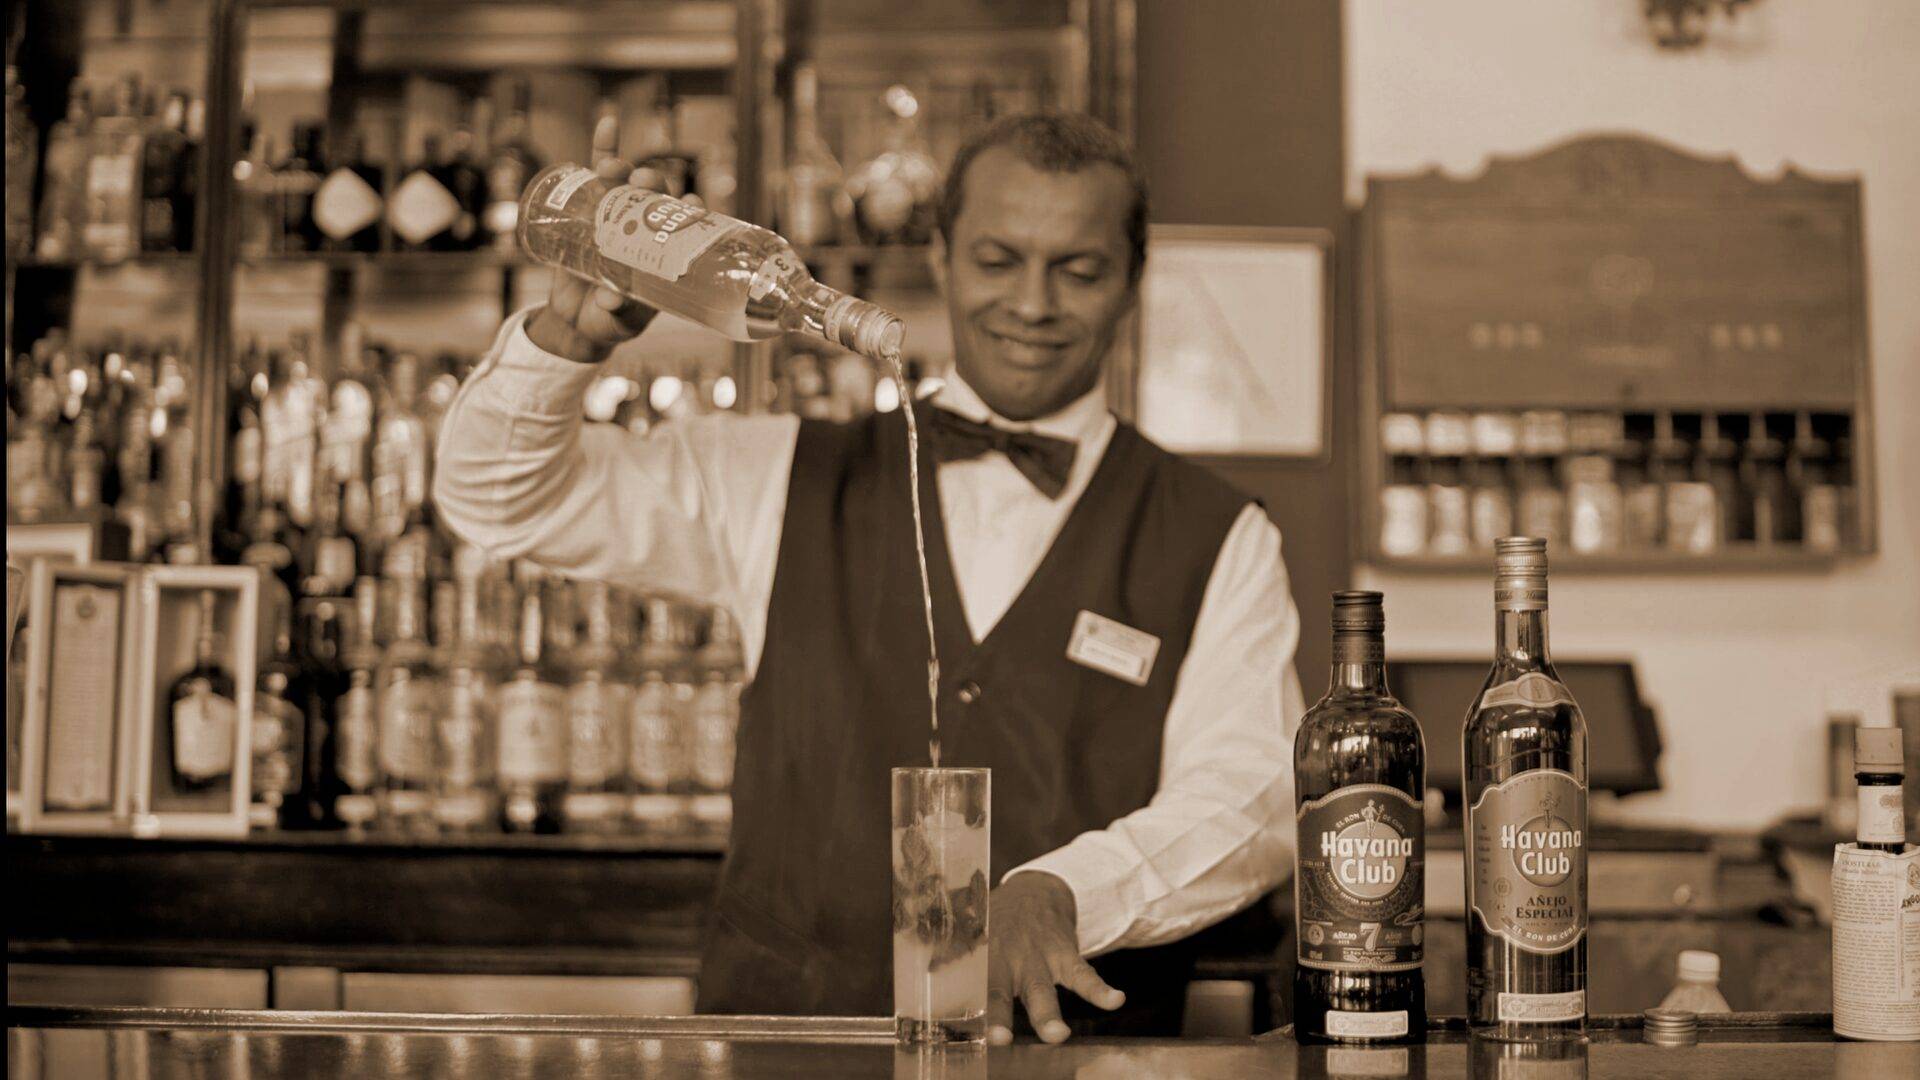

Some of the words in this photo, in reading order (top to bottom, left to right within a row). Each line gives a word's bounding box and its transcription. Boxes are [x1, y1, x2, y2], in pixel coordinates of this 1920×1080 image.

[648, 202, 683, 222] lub
[774, 257, 790, 272] 3
[1344, 813, 1361, 824] RON
[1321, 830, 1413, 858] Havana
[1501, 824, 1582, 850] Havana
[1340, 858, 1396, 885] Club
[1521, 851, 1571, 876] Club
[1526, 894, 1568, 907] AÑEJO
[1516, 906, 1575, 920] ESPECIAL
[1360, 922, 1381, 952] 7
[1512, 925, 1522, 935] EL
[1526, 931, 1544, 942] RON
[1546, 934, 1558, 942] DE
[1559, 924, 1577, 940] CUBA
